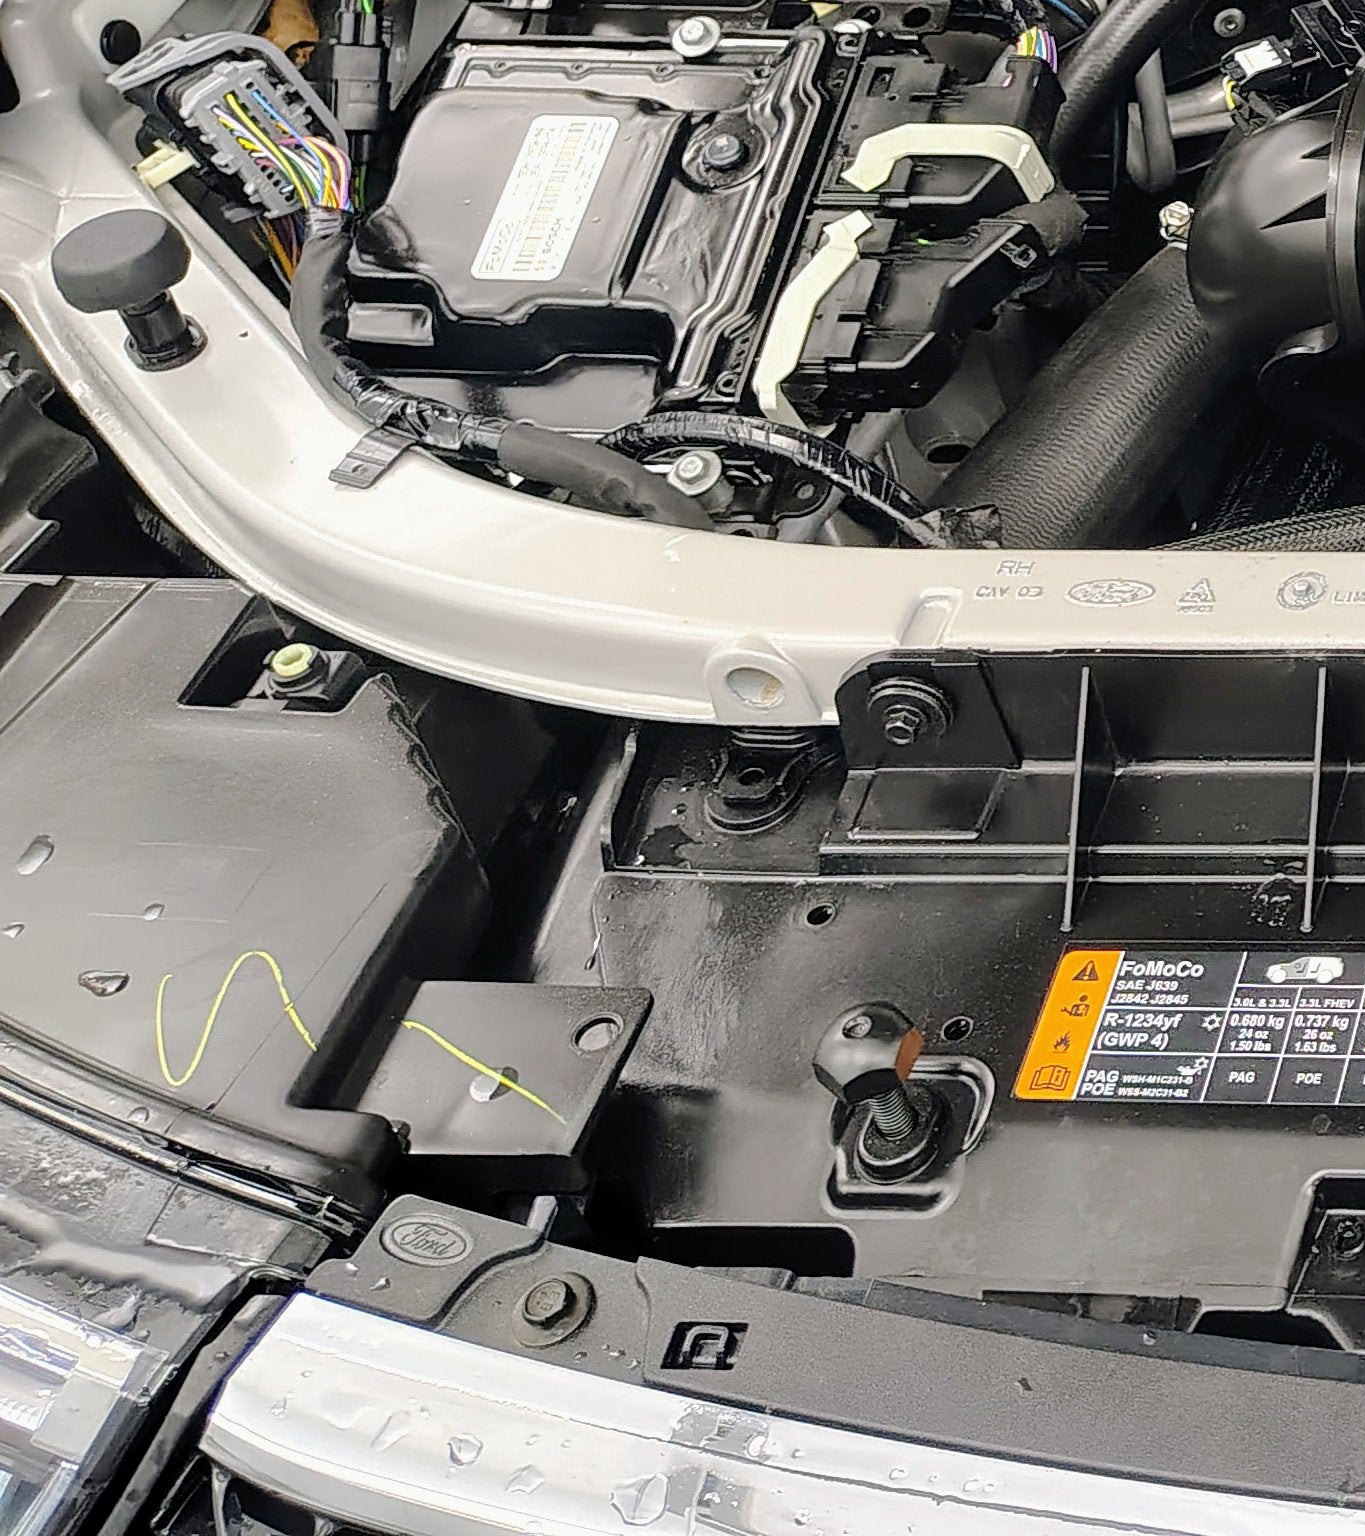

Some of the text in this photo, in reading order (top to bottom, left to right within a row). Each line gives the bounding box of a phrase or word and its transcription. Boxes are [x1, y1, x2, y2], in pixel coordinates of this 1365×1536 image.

[996, 560, 1036, 576] RH
[975, 585, 1010, 599] CAV
[1119, 961, 1204, 978] FoMoCo
[1115, 980, 1178, 991] SAE J639
[1111, 994, 1189, 1005] J2842 J2845
[1232, 998, 1291, 1007] 3.0L & 3.3L
[1299, 999, 1356, 1008] 3.3L FHEV
[1103, 1013, 1182, 1031] R-1234yf
[1230, 1014, 1285, 1030] 0.680 kg
[1295, 1014, 1350, 1030] 0.737 kg
[1238, 1028, 1269, 1039] 24 oz
[1303, 1029, 1334, 1040] 26 oz
[1097, 1032, 1169, 1050] (GWP 4)
[1230, 1040, 1272, 1051] 1.50 lbs
[1295, 1041, 1337, 1052] 1.63 lbs
[1085, 1070, 1119, 1083] PAG
[1229, 1072, 1255, 1083] PAG
[1296, 1073, 1323, 1084] POE
[1080, 1083, 1116, 1095] POE
